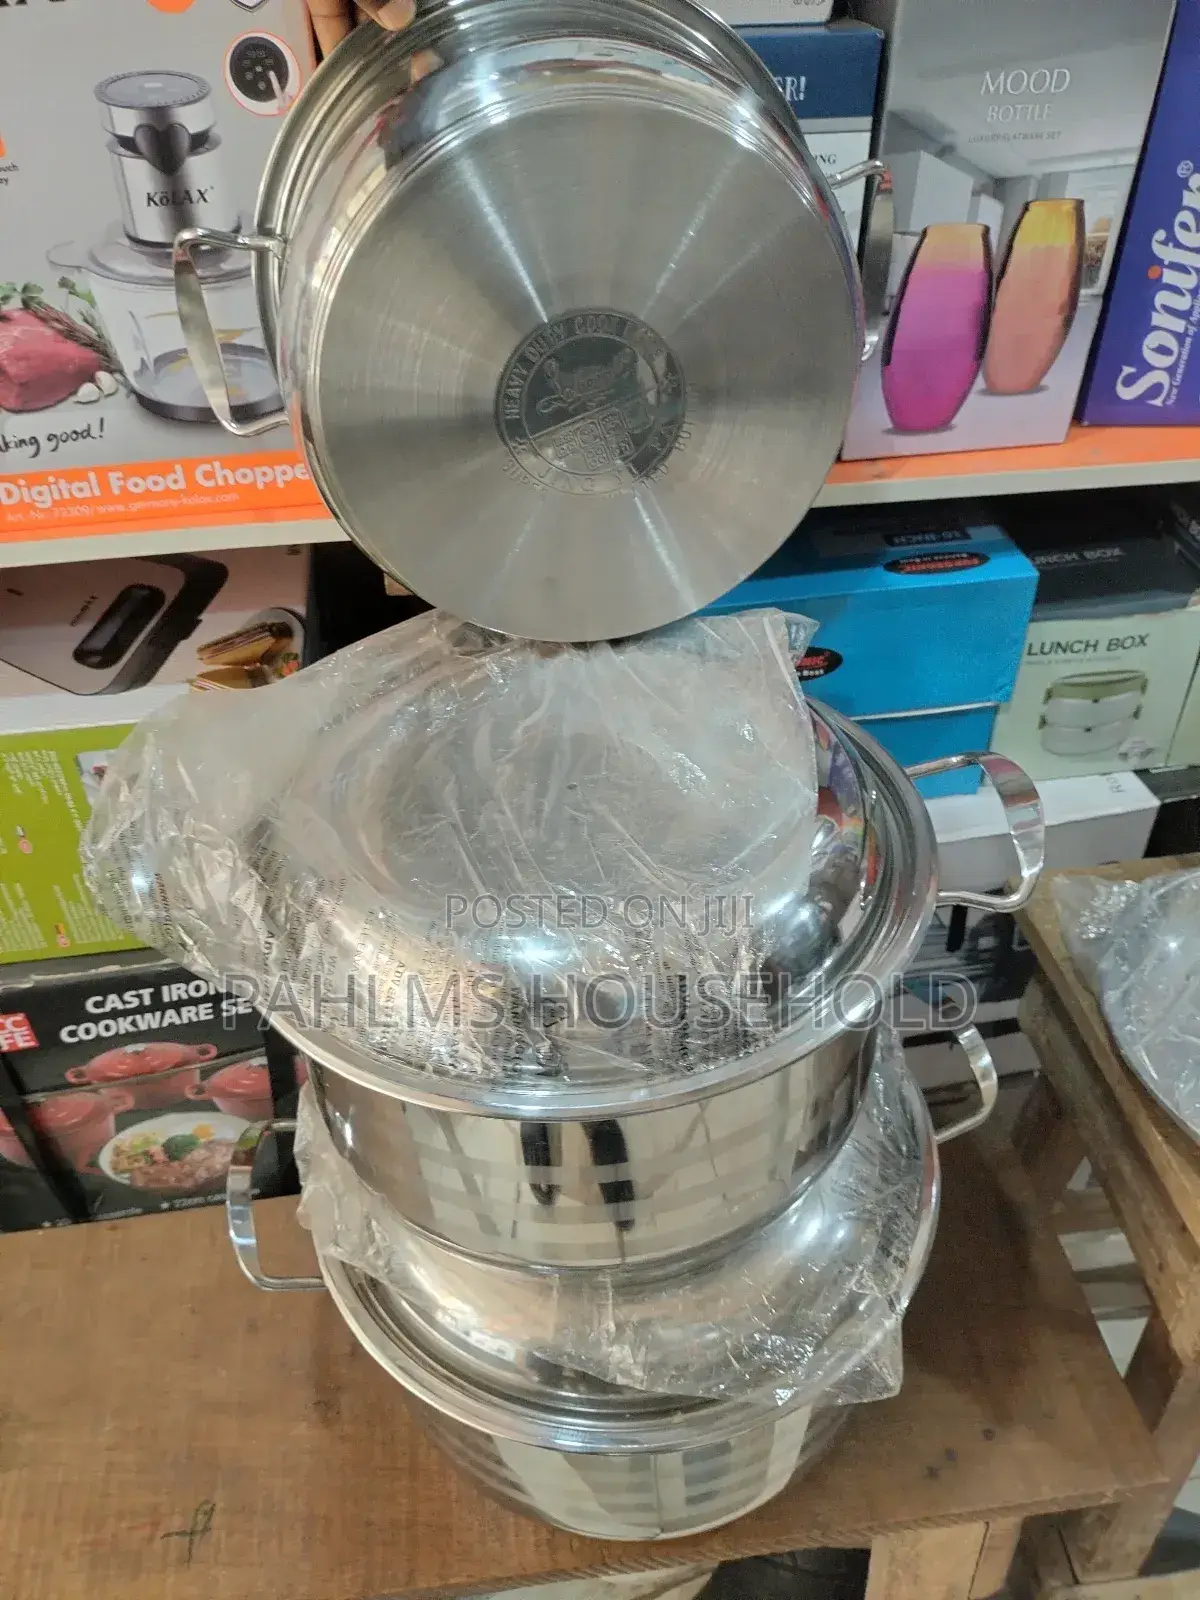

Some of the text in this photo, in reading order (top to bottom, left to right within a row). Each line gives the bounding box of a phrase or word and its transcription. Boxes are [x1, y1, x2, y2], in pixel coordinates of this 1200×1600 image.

[980, 68, 1071, 95] MOOD
[986, 102, 1054, 123] BOTTLE
[1171, 337, 1193, 386] Generation
[46, 417, 104, 452] good!
[0, 471, 101, 509] Digital
[109, 463, 187, 496] Food
[1027, 633, 1151, 657] LUNCH BOX
[84, 986, 155, 1015] CAST
[60, 1002, 215, 1044] COOKWARE
